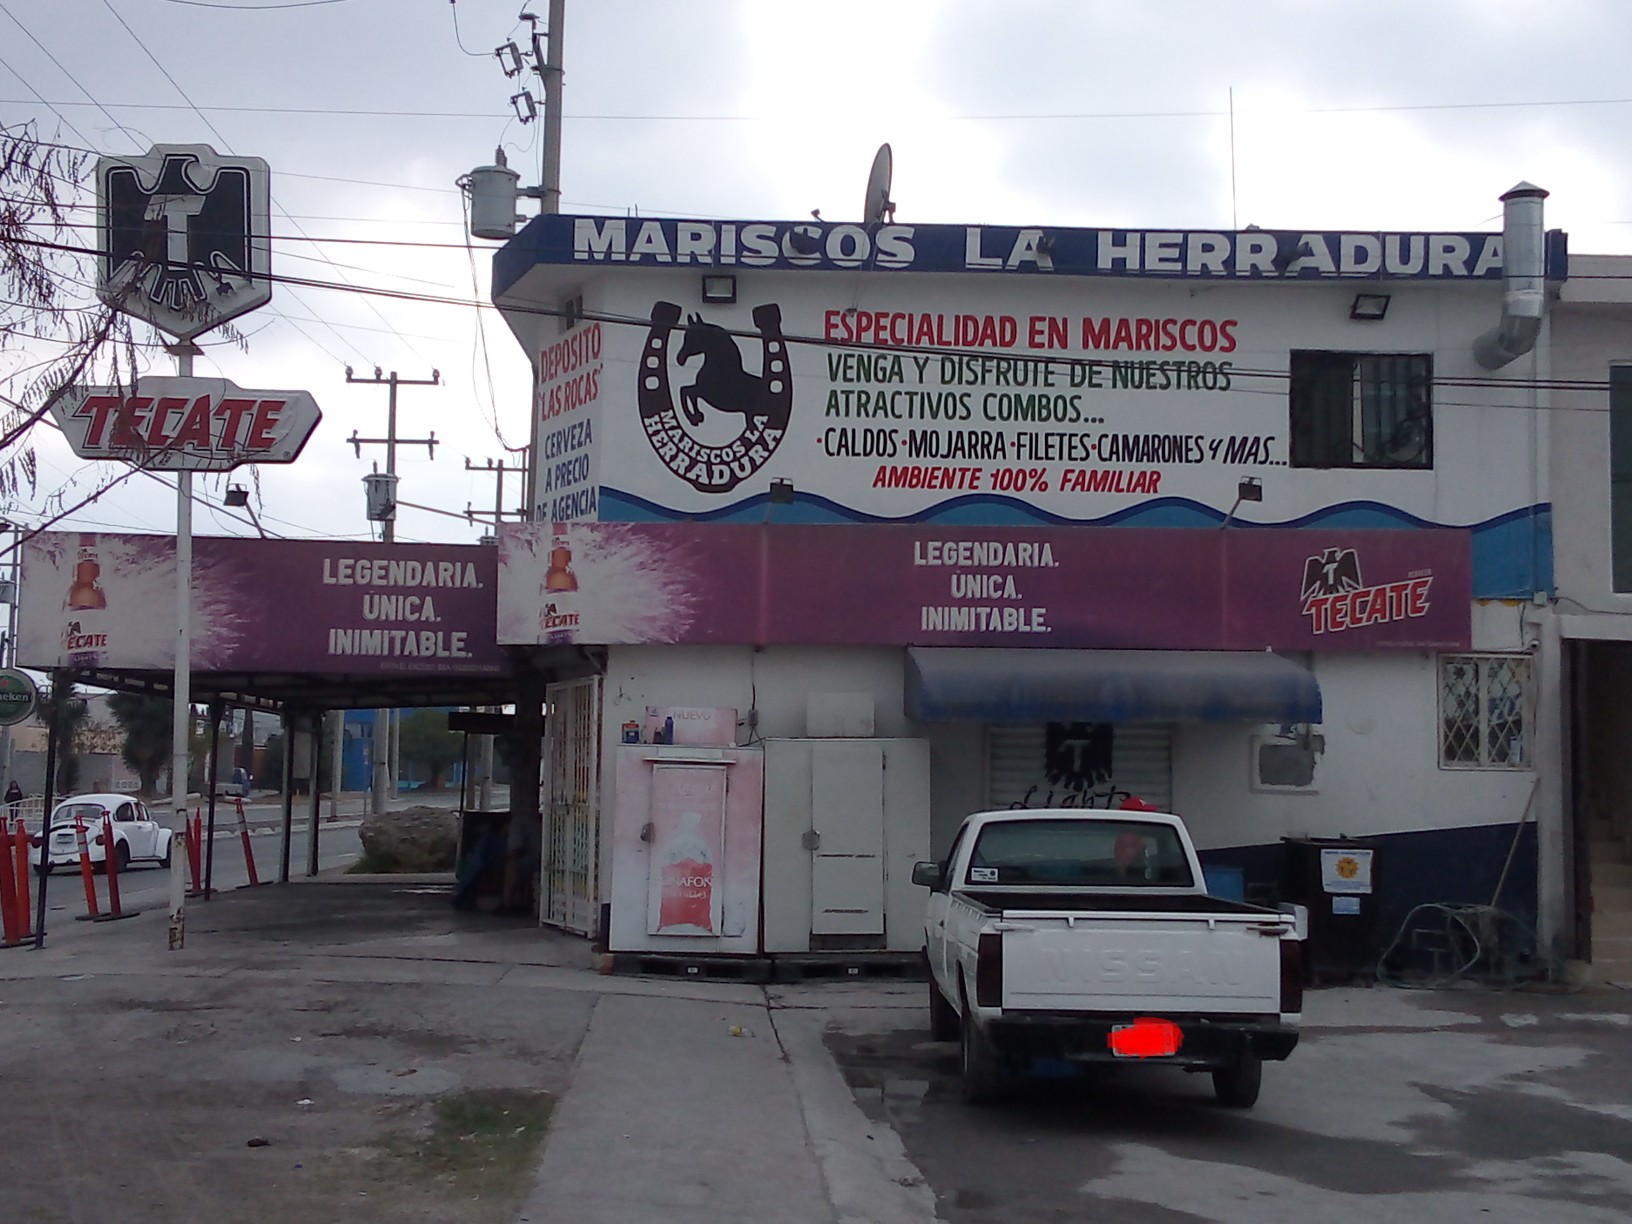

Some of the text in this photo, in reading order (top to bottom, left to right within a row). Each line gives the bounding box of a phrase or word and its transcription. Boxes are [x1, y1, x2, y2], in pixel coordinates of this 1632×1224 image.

[573, 218, 1504, 276] MARISCOS LA HERRADURA
[824, 310, 1238, 352] ESPECIALIDAD EN MARISCOS
[541, 322, 601, 384] DEPOSITO
[827, 353, 1232, 391] VENGA Y DISFRUTE DE NUESTROS
[74, 394, 287, 451] TECATE
[825, 389, 1105, 424] ATRACTIVOS COMBOS...
[545, 418, 592, 460] CERVEZA
[644, 414, 783, 486] HERRADURA
[660, 409, 769, 463] MARISCOS LA
[824, 427, 898, 459] CALDOS
[908, 429, 1006, 461] MOJARRA
[1016, 432, 1090, 462] FILETES
[1098, 434, 1204, 465] CAMARONES
[1223, 435, 1287, 466] MAS...
[545, 453, 589, 493] A PRECIO
[873, 466, 1161, 495] AMBIENTE 100% FAMILIAR
[551, 486, 597, 522] AGENCIA
[322, 558, 484, 589] LEGENDARIA.
[914, 541, 1060, 568] LEGENDARIA.
[544, 613, 580, 629] ECATE
[920, 605, 1053, 633] INIMITABLE.
[1303, 577, 1433, 634] TECATE
[67, 633, 108, 650] ECATE
[327, 628, 474, 659] INIMITABLE.
[672, 710, 711, 721] NUEVO
[1038, 948, 1243, 986] NISSAN
